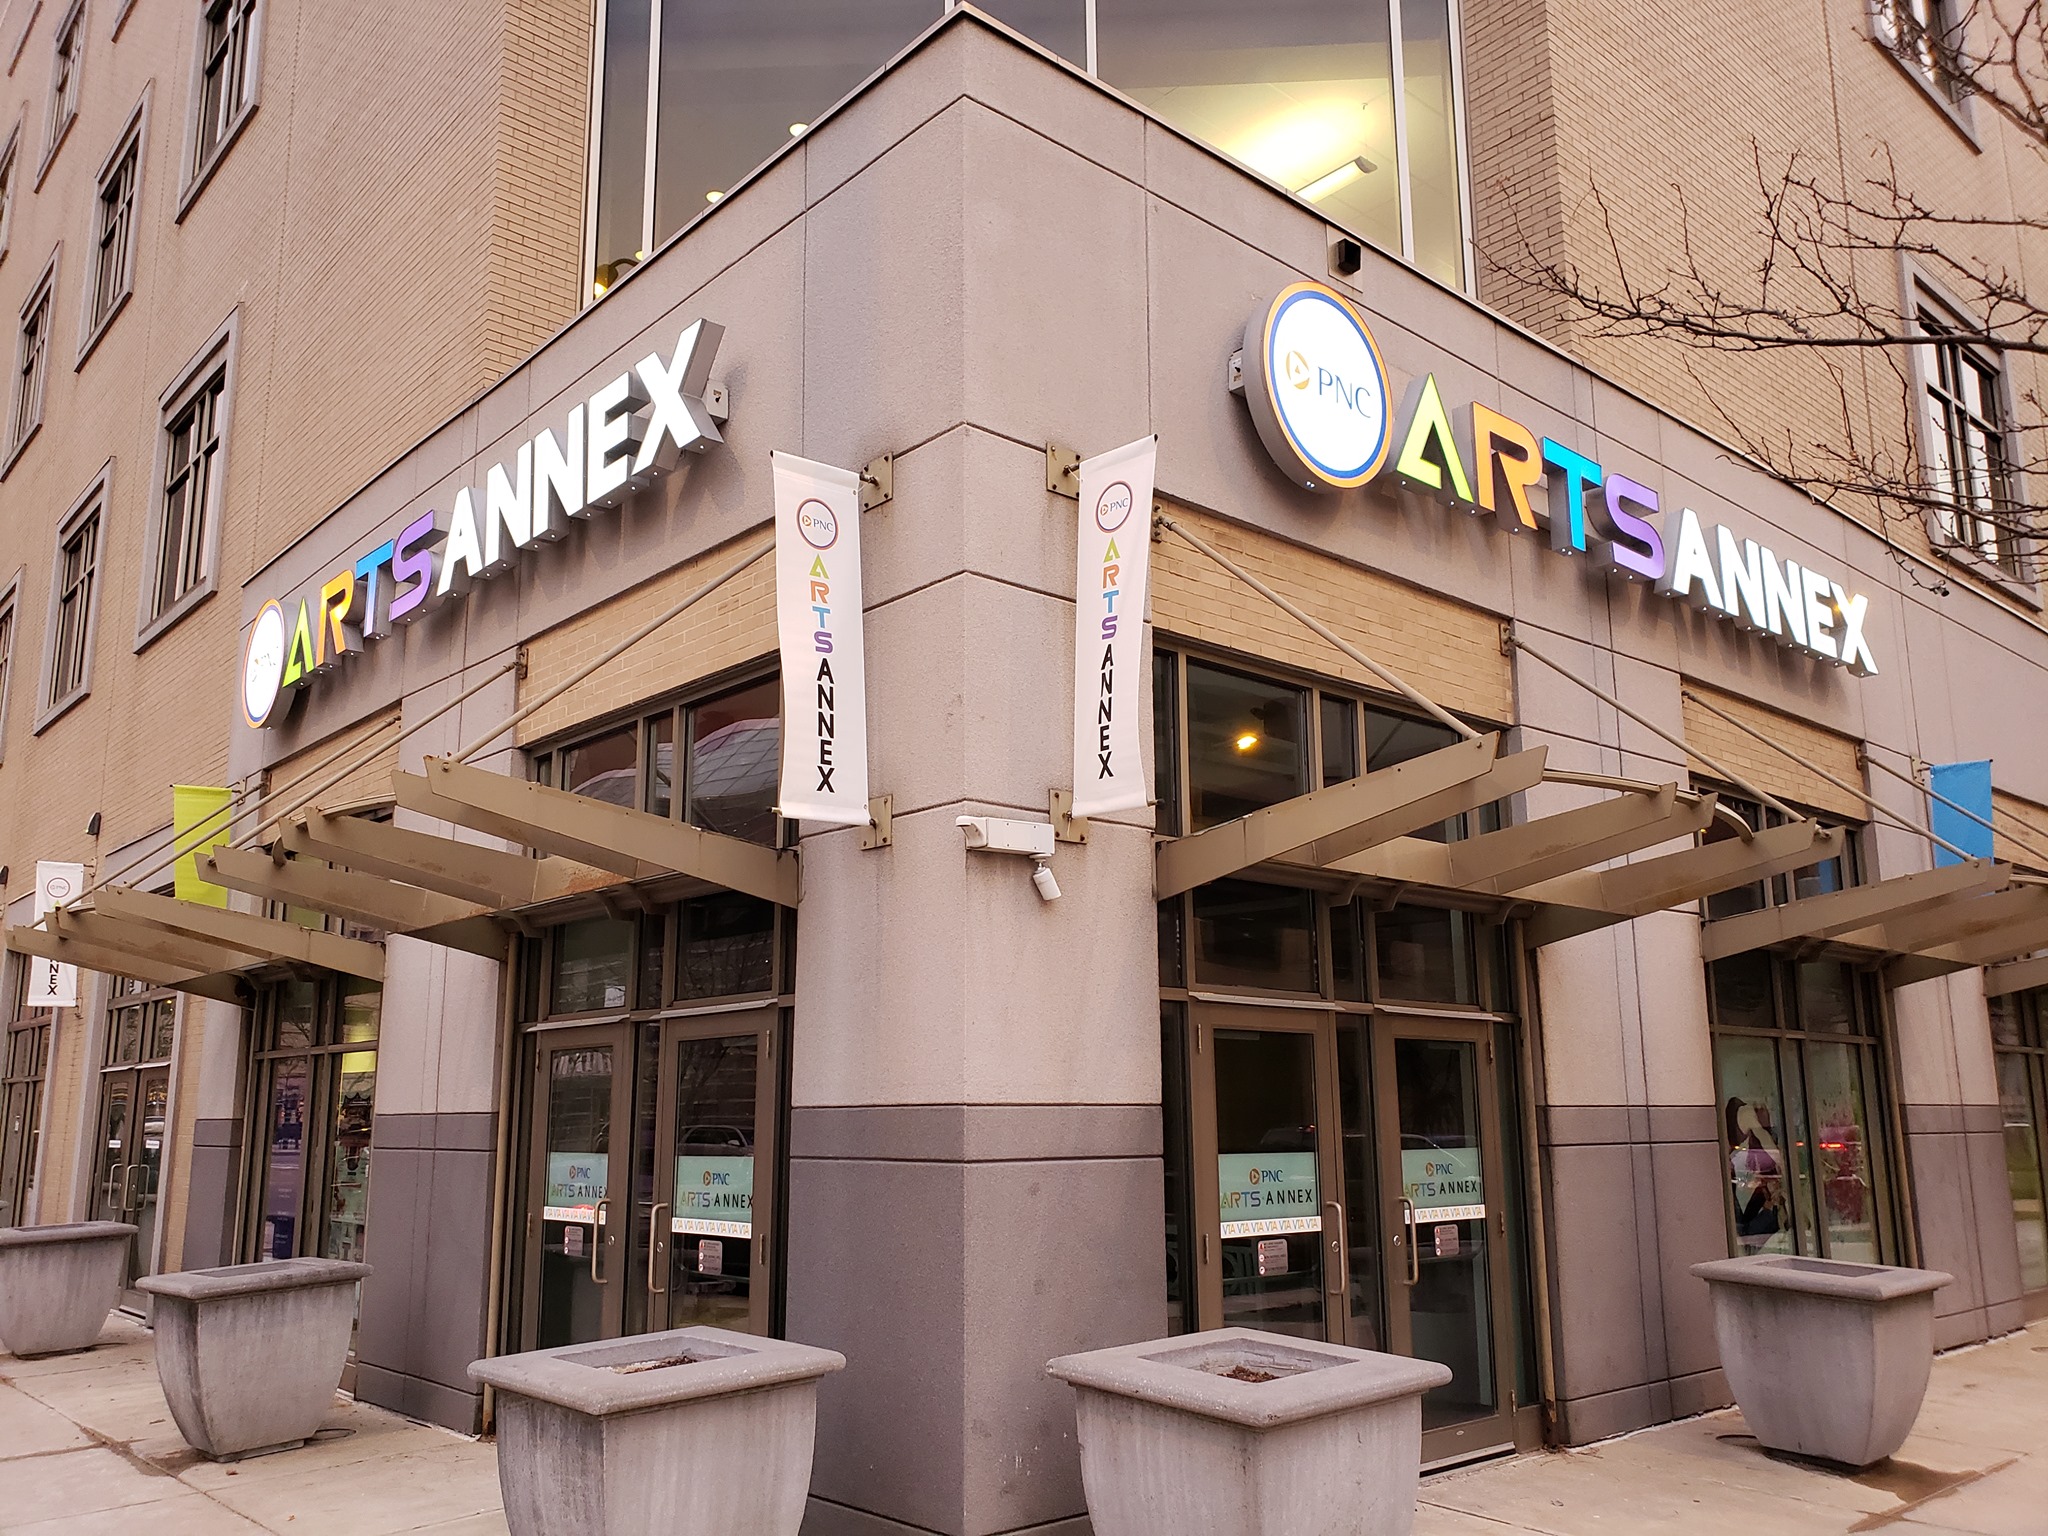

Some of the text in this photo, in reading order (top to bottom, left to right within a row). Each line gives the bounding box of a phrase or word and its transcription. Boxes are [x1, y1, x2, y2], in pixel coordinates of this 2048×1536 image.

[1318, 366, 1371, 418] PNC
[283, 318, 706, 687] ARTS ANNEX
[1109, 496, 1128, 513] PNC
[813, 517, 834, 533] PNC
[1396, 373, 1879, 676] ARTS ANNEX
[1097, 536, 1120, 780] ARTS ANNEX
[809, 553, 835, 794] ARTS ANNEX
[576, 1167, 591, 1179] PNC
[1261, 1169, 1283, 1183] PNC
[1436, 1163, 1453, 1175] PNC
[712, 1172, 730, 1186] PNC
[551, 1183, 575, 1198] ARTS
[1220, 1188, 1313, 1208] ARTS ANNEX
[1403, 1180, 1478, 1198] ARTS ANNEX
[681, 1191, 753, 1209] ARTS ANNEX
